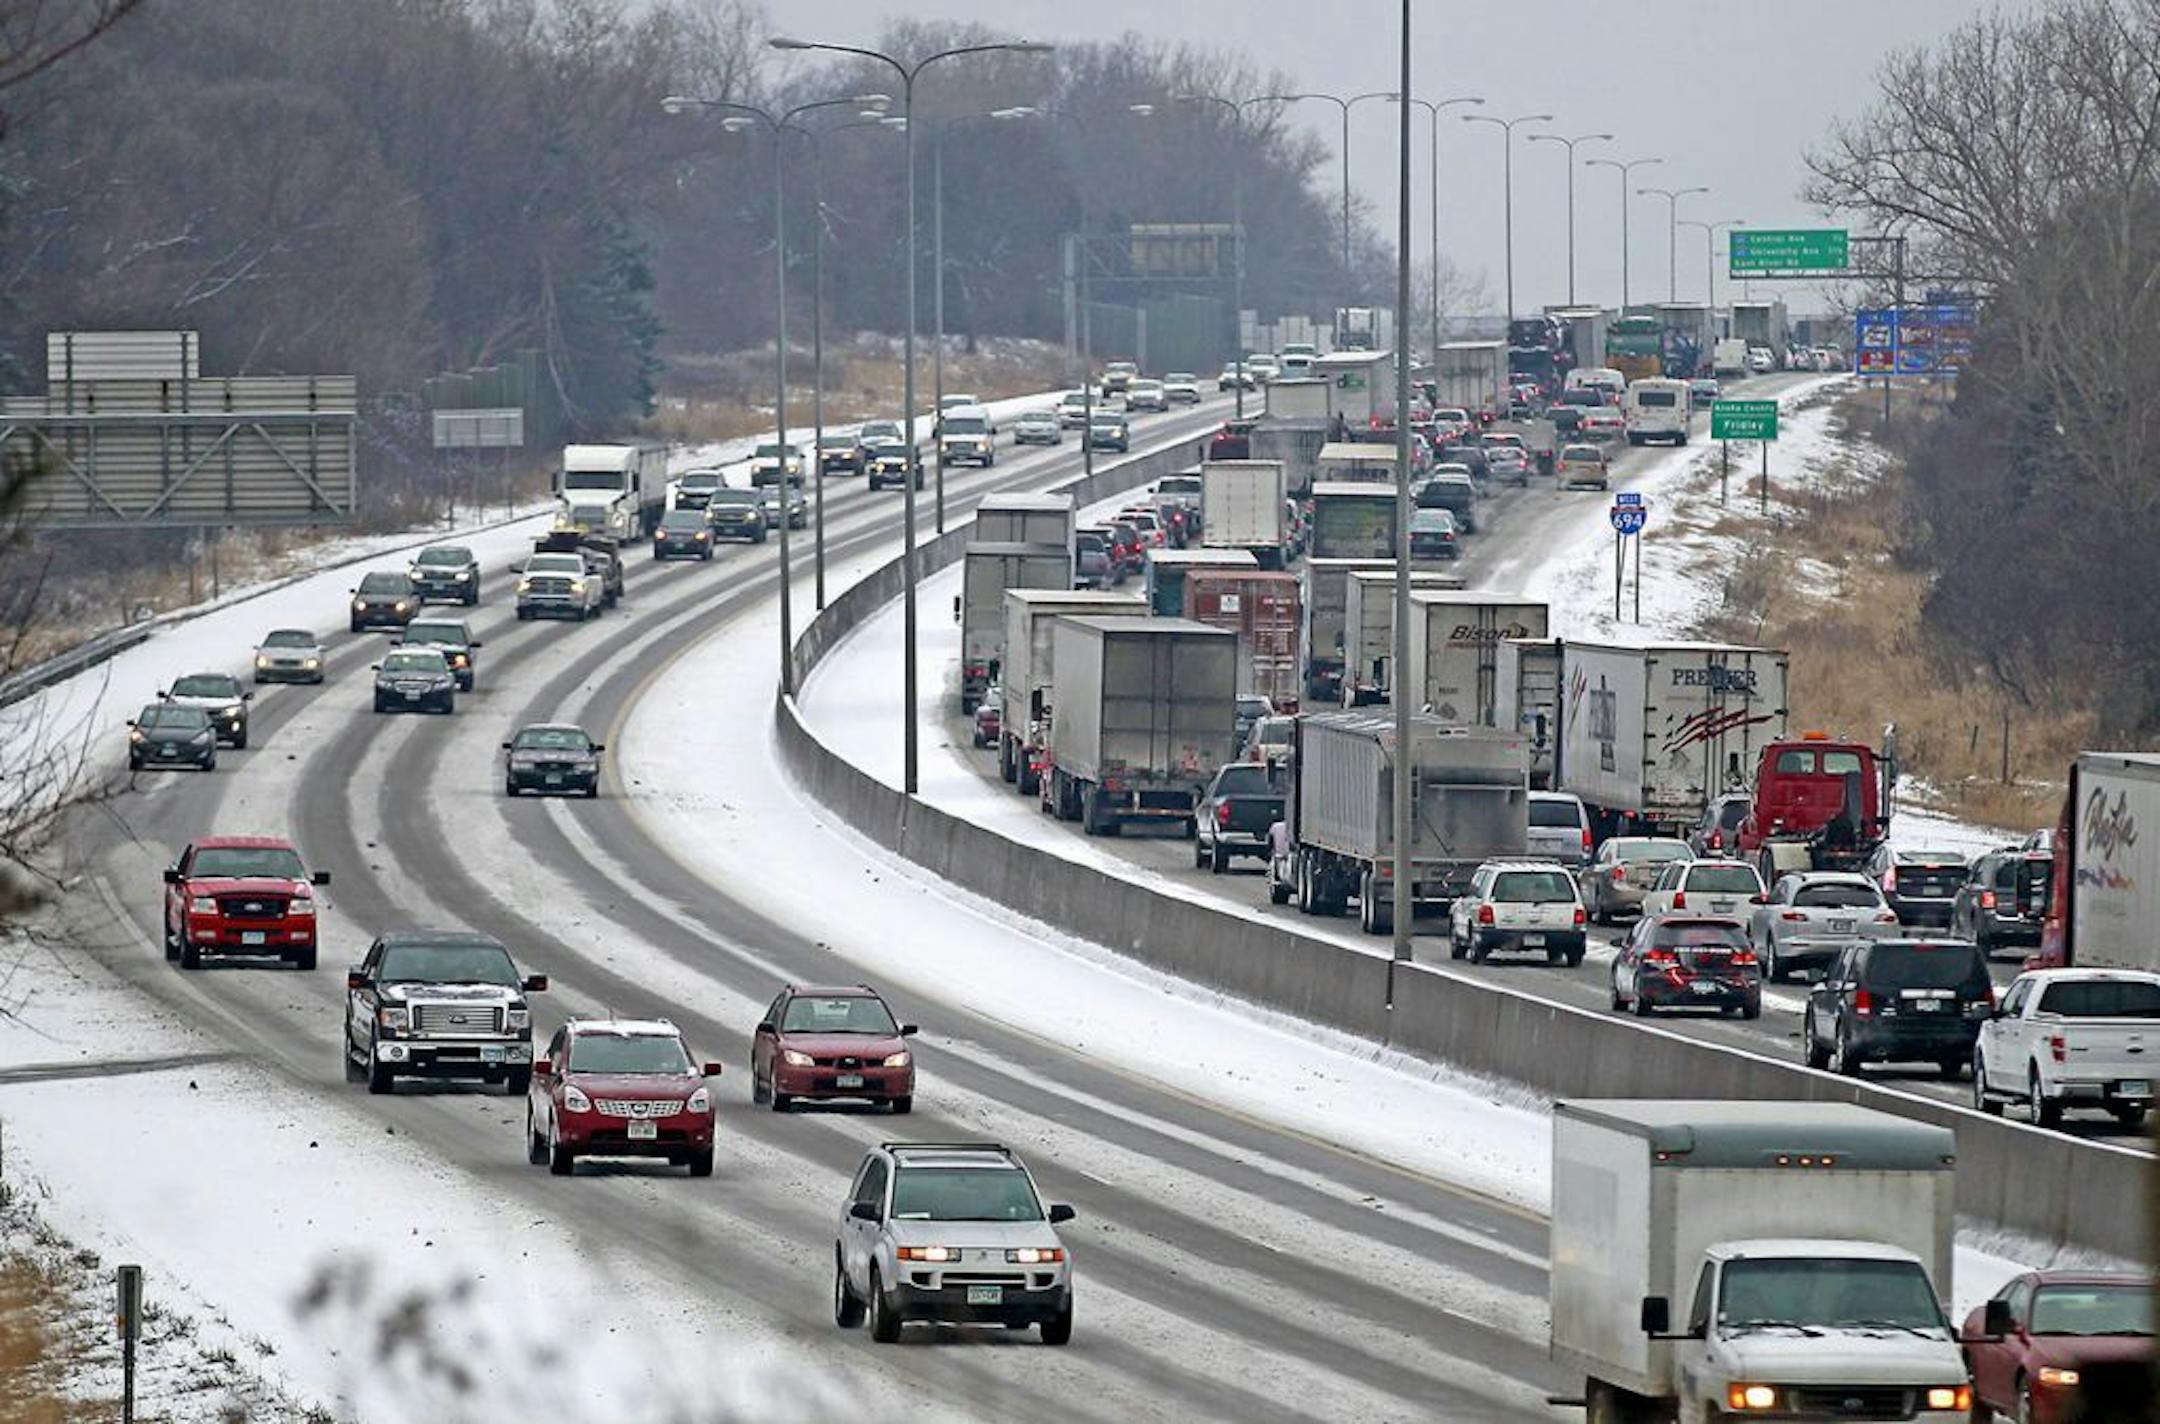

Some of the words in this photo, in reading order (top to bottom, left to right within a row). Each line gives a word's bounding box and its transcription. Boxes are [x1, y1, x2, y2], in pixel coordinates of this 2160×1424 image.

[1723, 419, 1764, 432] Fridley
[1614, 513, 1643, 529] 694
[1450, 625, 1511, 640] Bison
